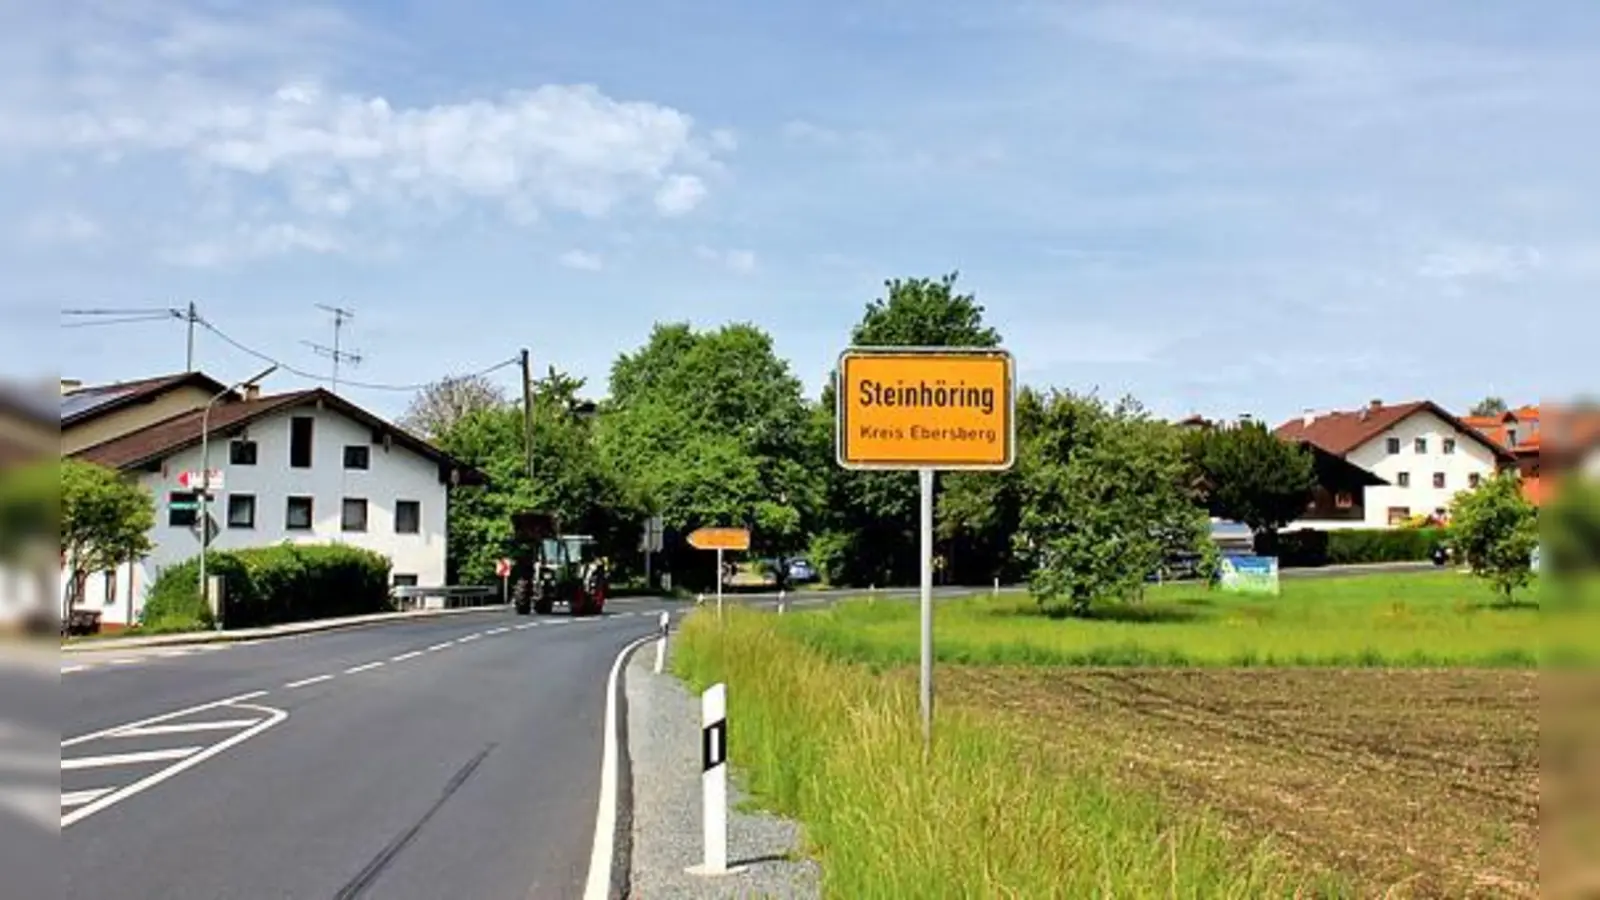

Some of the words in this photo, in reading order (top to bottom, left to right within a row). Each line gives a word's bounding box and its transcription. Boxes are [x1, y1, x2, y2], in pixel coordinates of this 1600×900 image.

[859, 379, 994, 415] Steinhöring
[859, 425, 904, 440] Kreis
[909, 425, 996, 444] Ebersberg
